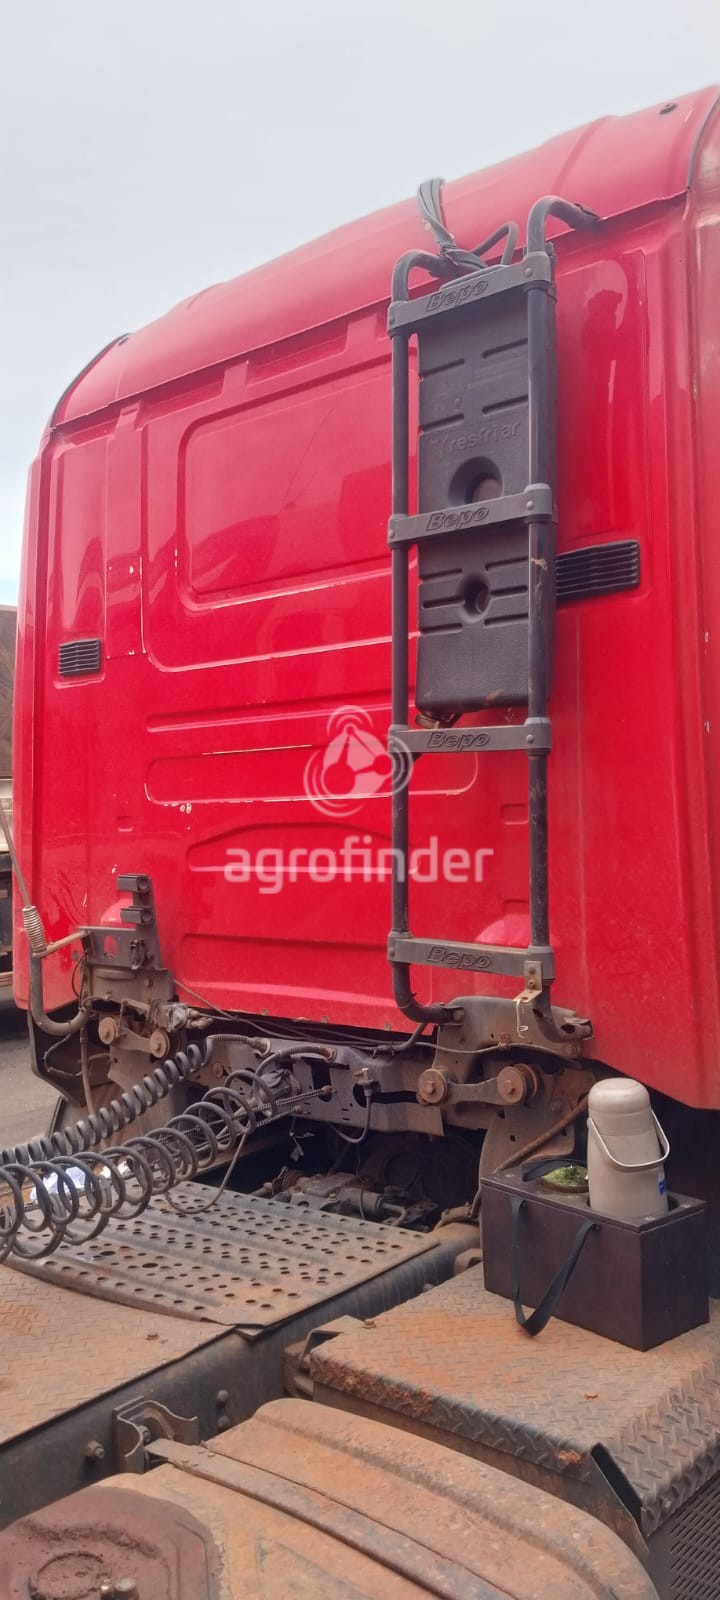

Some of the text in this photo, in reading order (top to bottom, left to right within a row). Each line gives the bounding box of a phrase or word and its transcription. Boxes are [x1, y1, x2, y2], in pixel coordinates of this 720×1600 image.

[426, 281, 488, 312] Bepo
[426, 507, 489, 531] Bepo
[427, 732, 490, 751] Bepo
[427, 946, 491, 969] Bepo
